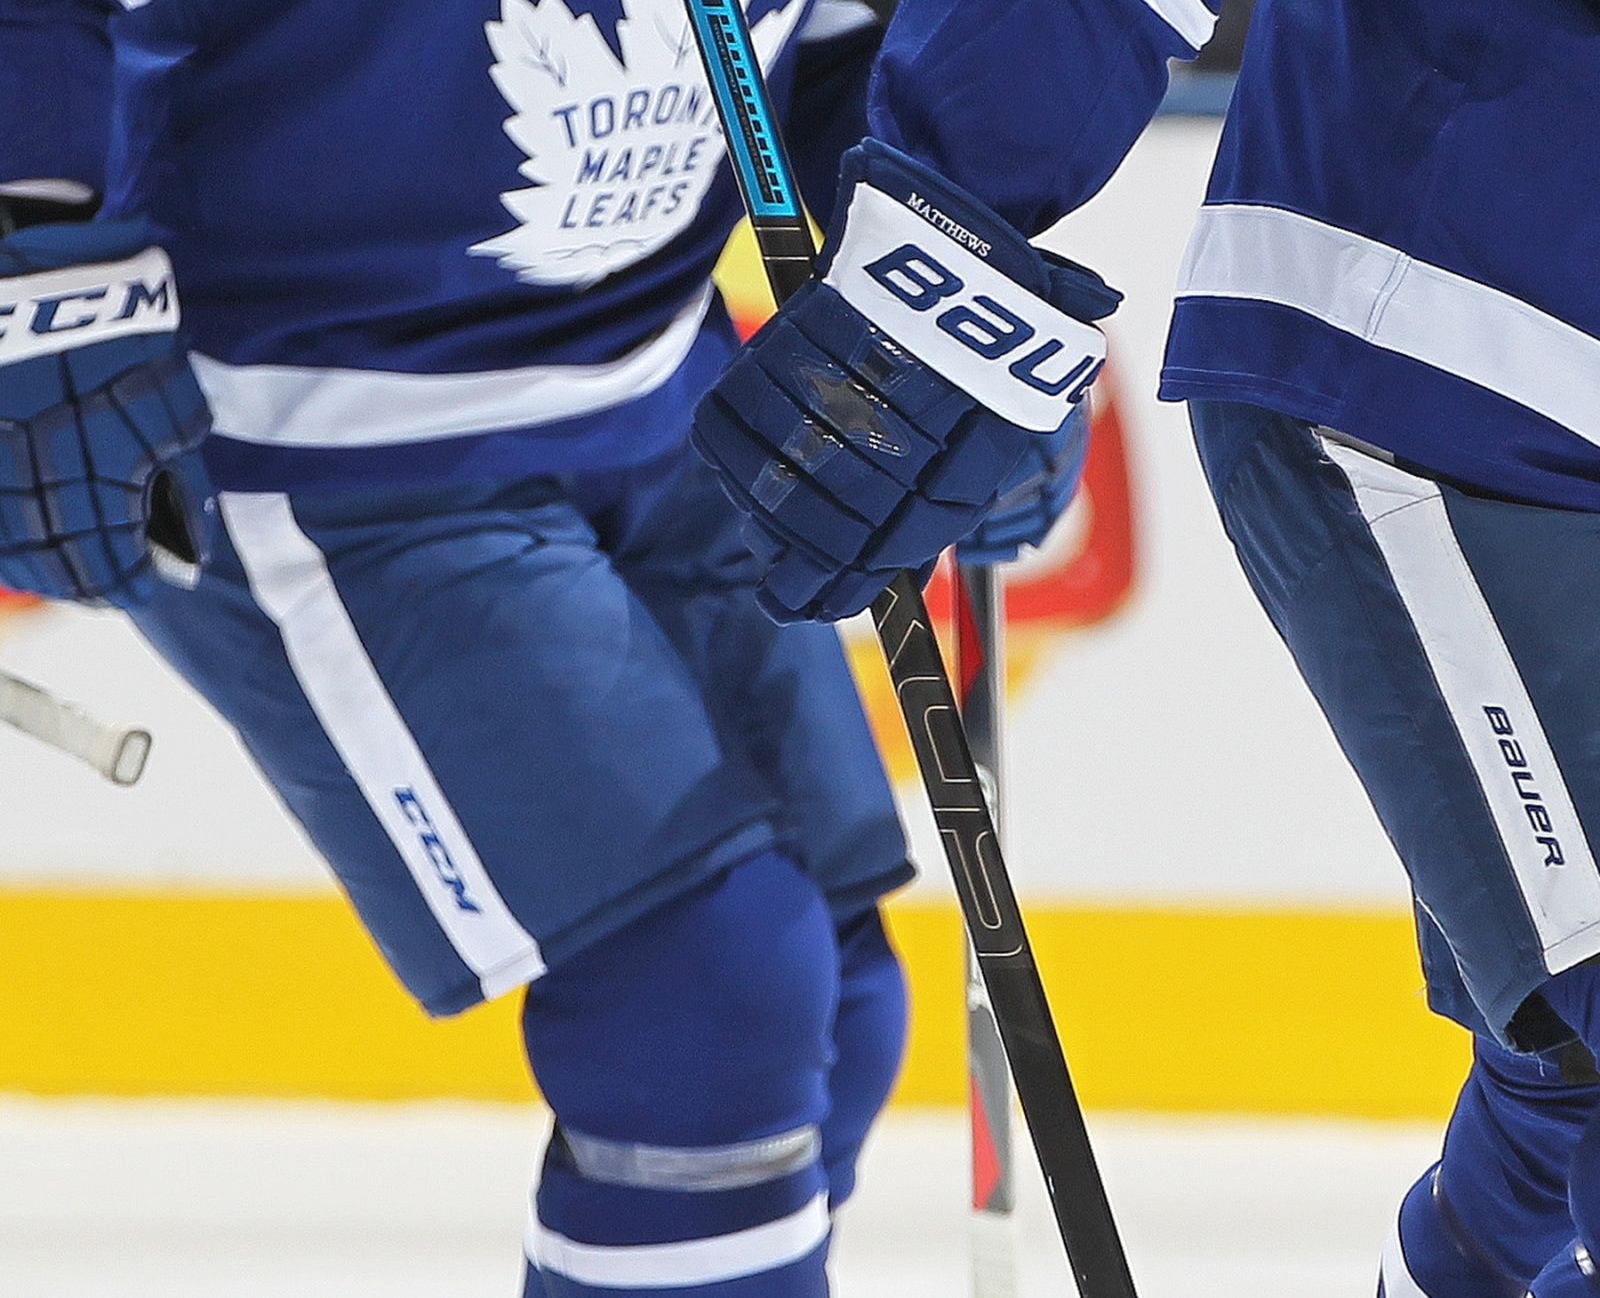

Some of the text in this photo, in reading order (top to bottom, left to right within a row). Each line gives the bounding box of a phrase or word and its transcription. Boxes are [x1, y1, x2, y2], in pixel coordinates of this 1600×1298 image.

[552, 85, 724, 148] TORON
[575, 136, 707, 185] MAPLE
[558, 181, 690, 229] LEAFS
[906, 191, 993, 258] MATTHEWS
[1482, 705, 1566, 868] BAUER
[394, 787, 483, 916] CCM
